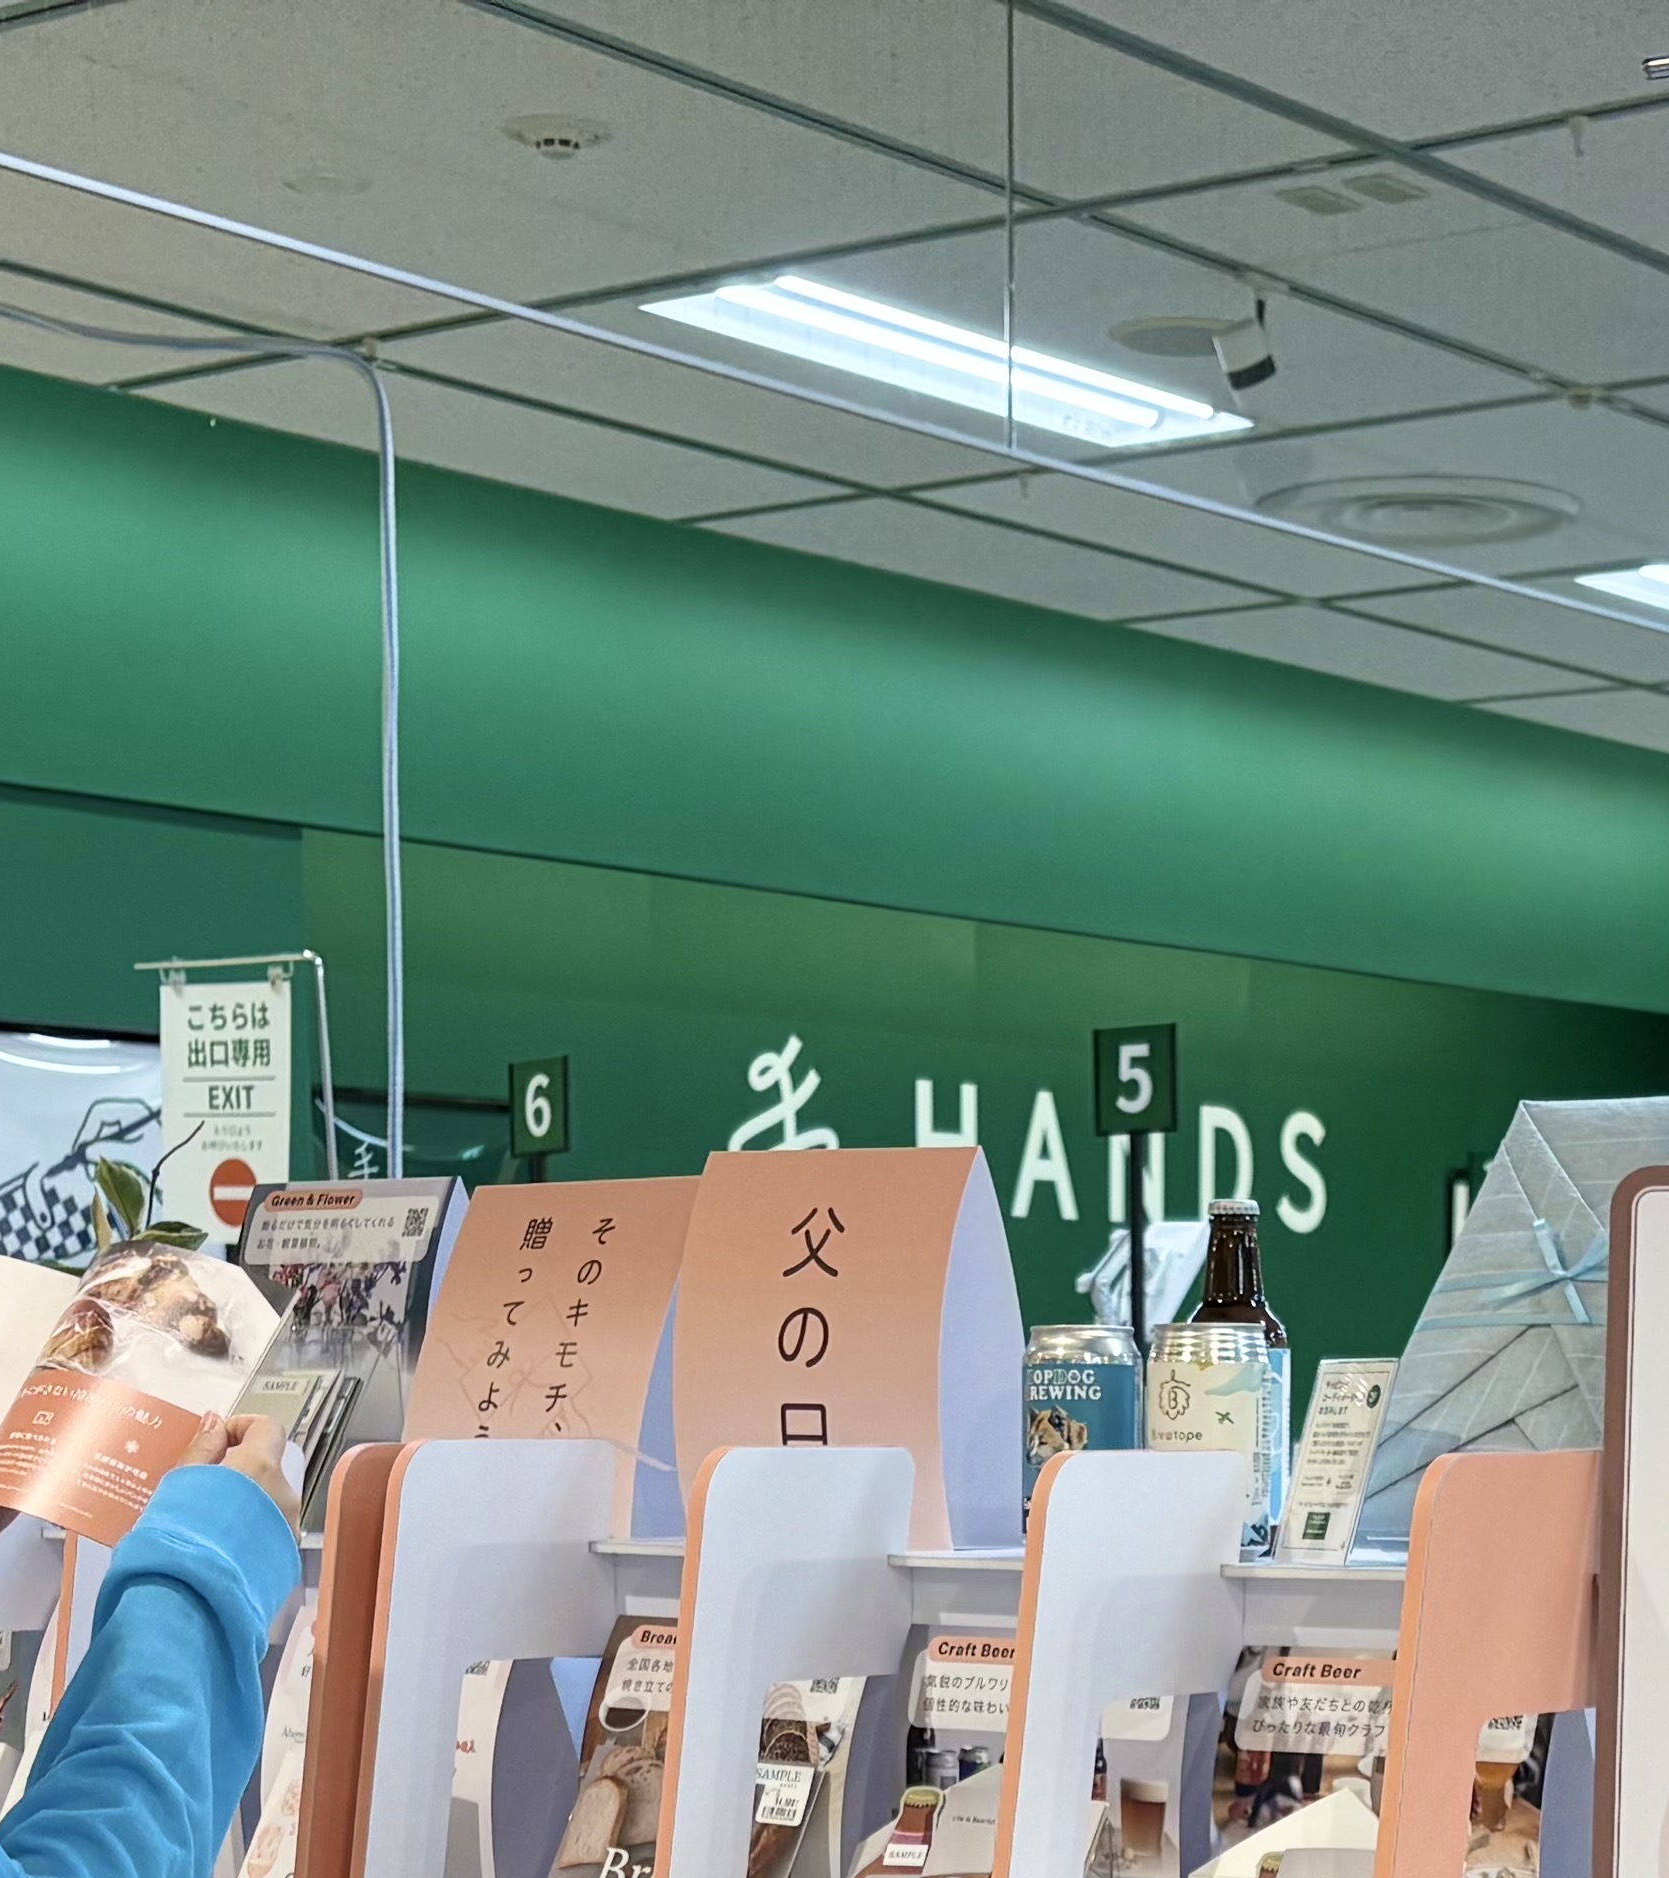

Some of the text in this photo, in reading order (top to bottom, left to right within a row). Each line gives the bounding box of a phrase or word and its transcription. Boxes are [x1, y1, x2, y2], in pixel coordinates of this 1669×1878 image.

[188, 1002, 270, 1031] こちらは
[188, 1038, 271, 1068] 出口専用
[1116, 1043, 1152, 1114] 5
[209, 1085, 254, 1110] EXIT
[524, 1073, 552, 1138] 6
[915, 1079, 1327, 1234] HANDS
[271, 1193, 305, 1207] Green
[316, 1193, 356, 1207] Flower
[543, 1215, 618, 1435] そのキモチ、
[778, 1206, 847, 1447] 父の日
[938, 1641, 1015, 1659] Craft Beer
[1273, 1662, 1362, 1679] Craft Beer
[756, 1767, 802, 1783] SAMPLE
[889, 1850, 922, 1860] SAMPLE
